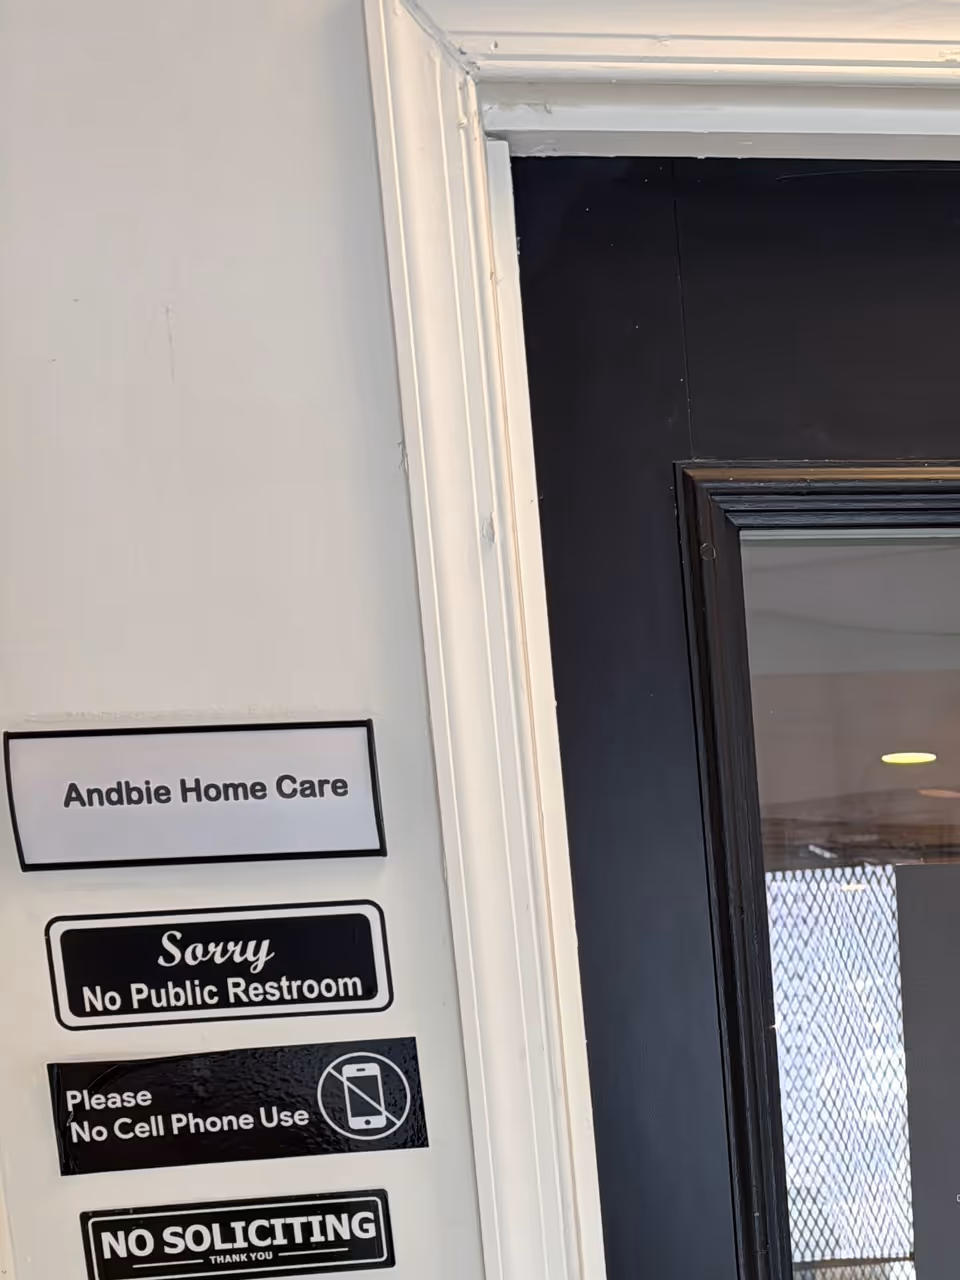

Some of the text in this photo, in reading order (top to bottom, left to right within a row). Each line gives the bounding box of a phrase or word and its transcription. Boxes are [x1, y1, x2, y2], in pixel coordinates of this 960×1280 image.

[63, 774, 349, 808] Andbie Home Care
[157, 930, 275, 974] Sorry
[82, 975, 363, 1012] No Public Restroom
[65, 1089, 153, 1112] Please
[70, 1106, 310, 1143] No Cell Phone Use
[101, 1211, 376, 1259] NO SOLICITING
[209, 1250, 273, 1265] THANK YOU
